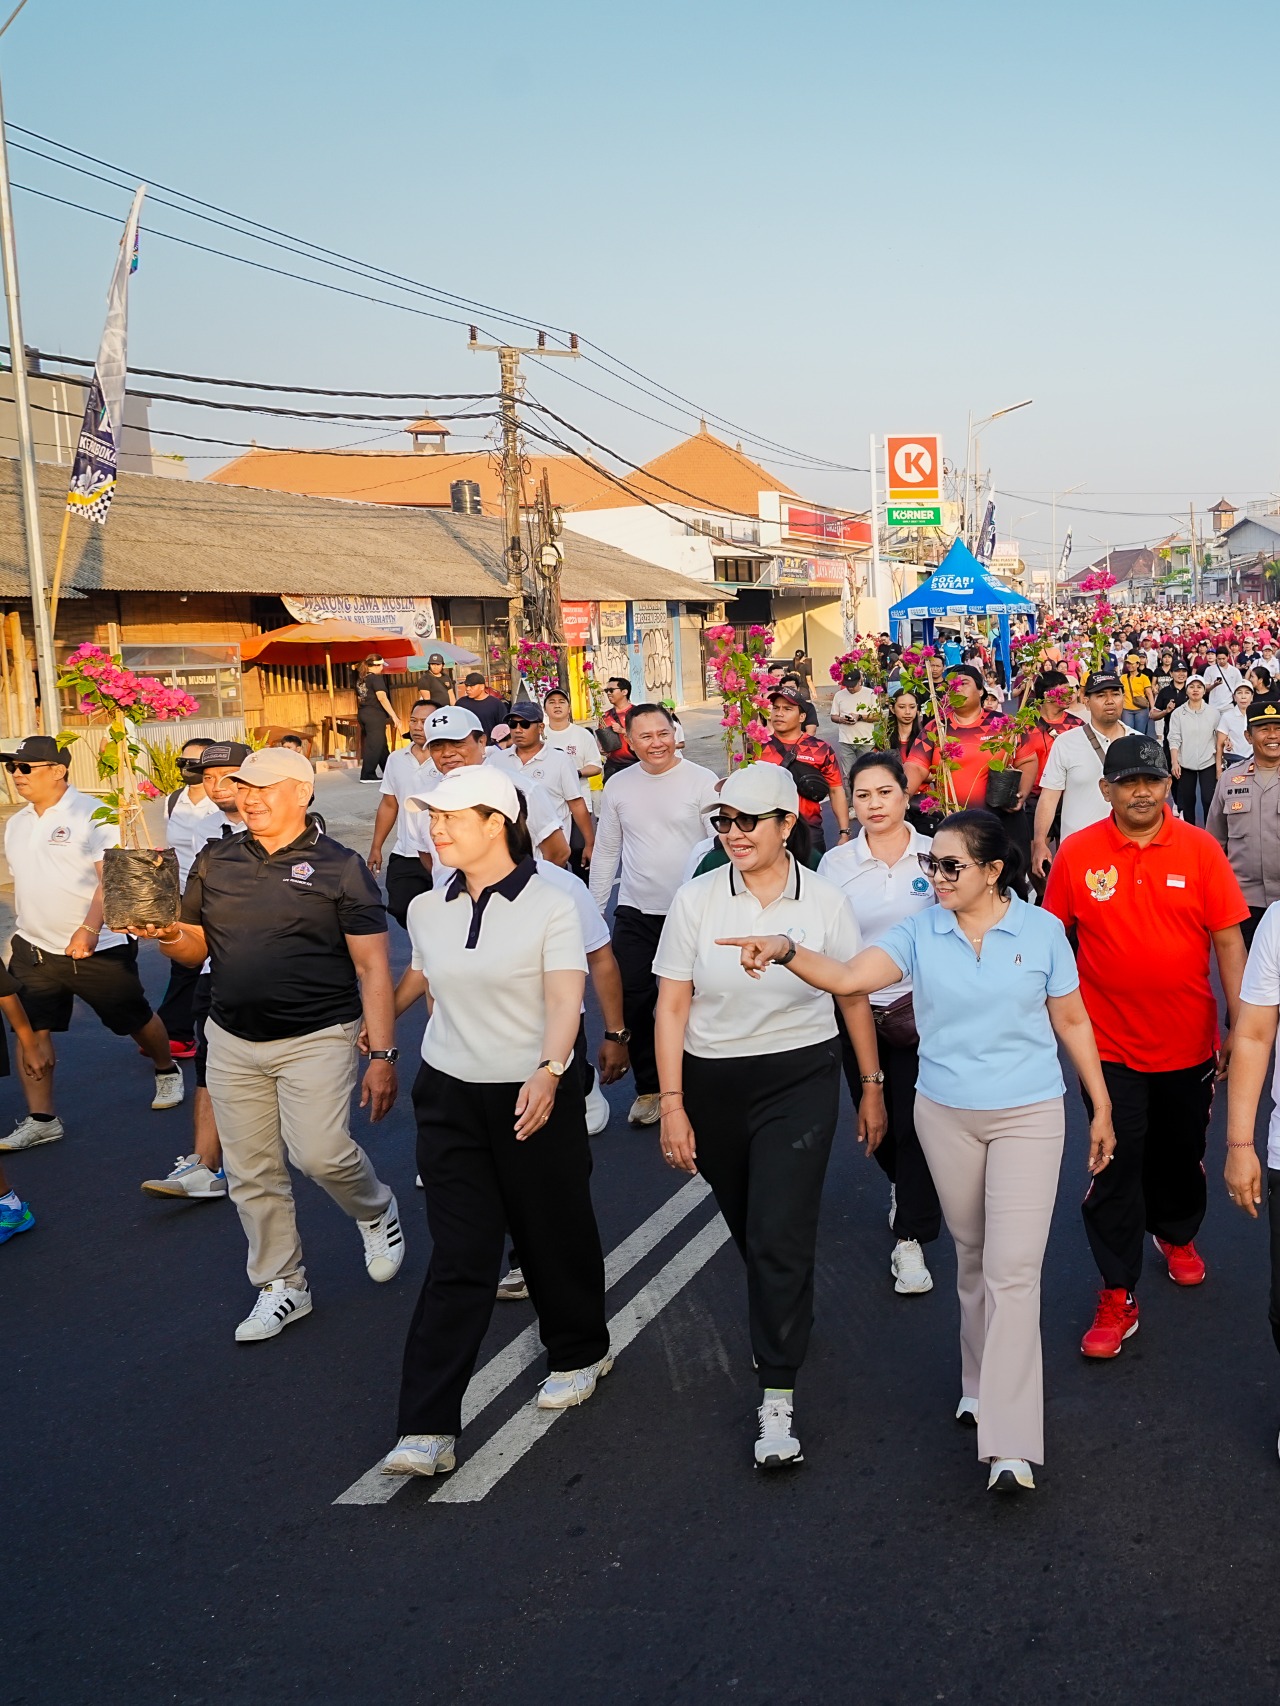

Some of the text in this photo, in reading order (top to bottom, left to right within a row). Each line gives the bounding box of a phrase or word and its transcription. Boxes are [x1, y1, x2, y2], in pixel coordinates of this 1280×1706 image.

[303, 596, 416, 613] WARUNG JAWA MUSLIM
[188, 675, 216, 685] MUSLIM
